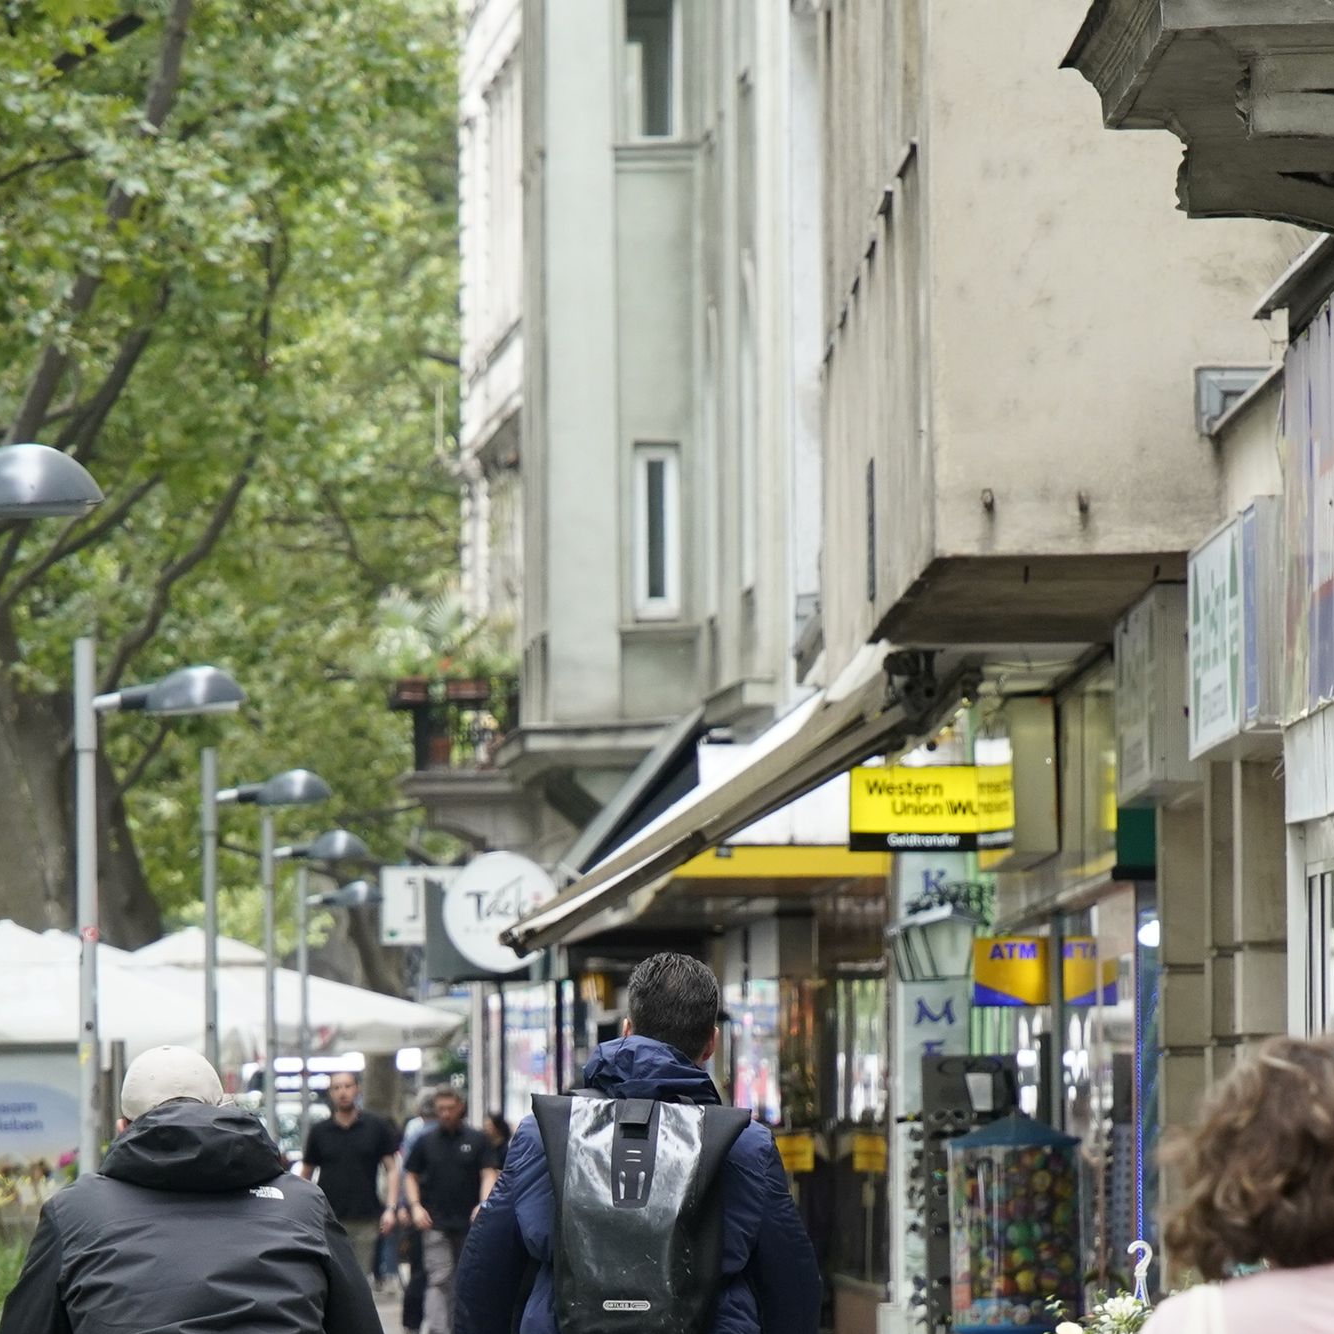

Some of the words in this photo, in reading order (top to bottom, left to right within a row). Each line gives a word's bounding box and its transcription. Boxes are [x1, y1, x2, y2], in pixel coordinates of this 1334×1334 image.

[865, 779, 944, 797] Western
[892, 800, 943, 816] Union
[887, 834, 961, 847] Geldtransfer
[990, 942, 1037, 960] ATM
